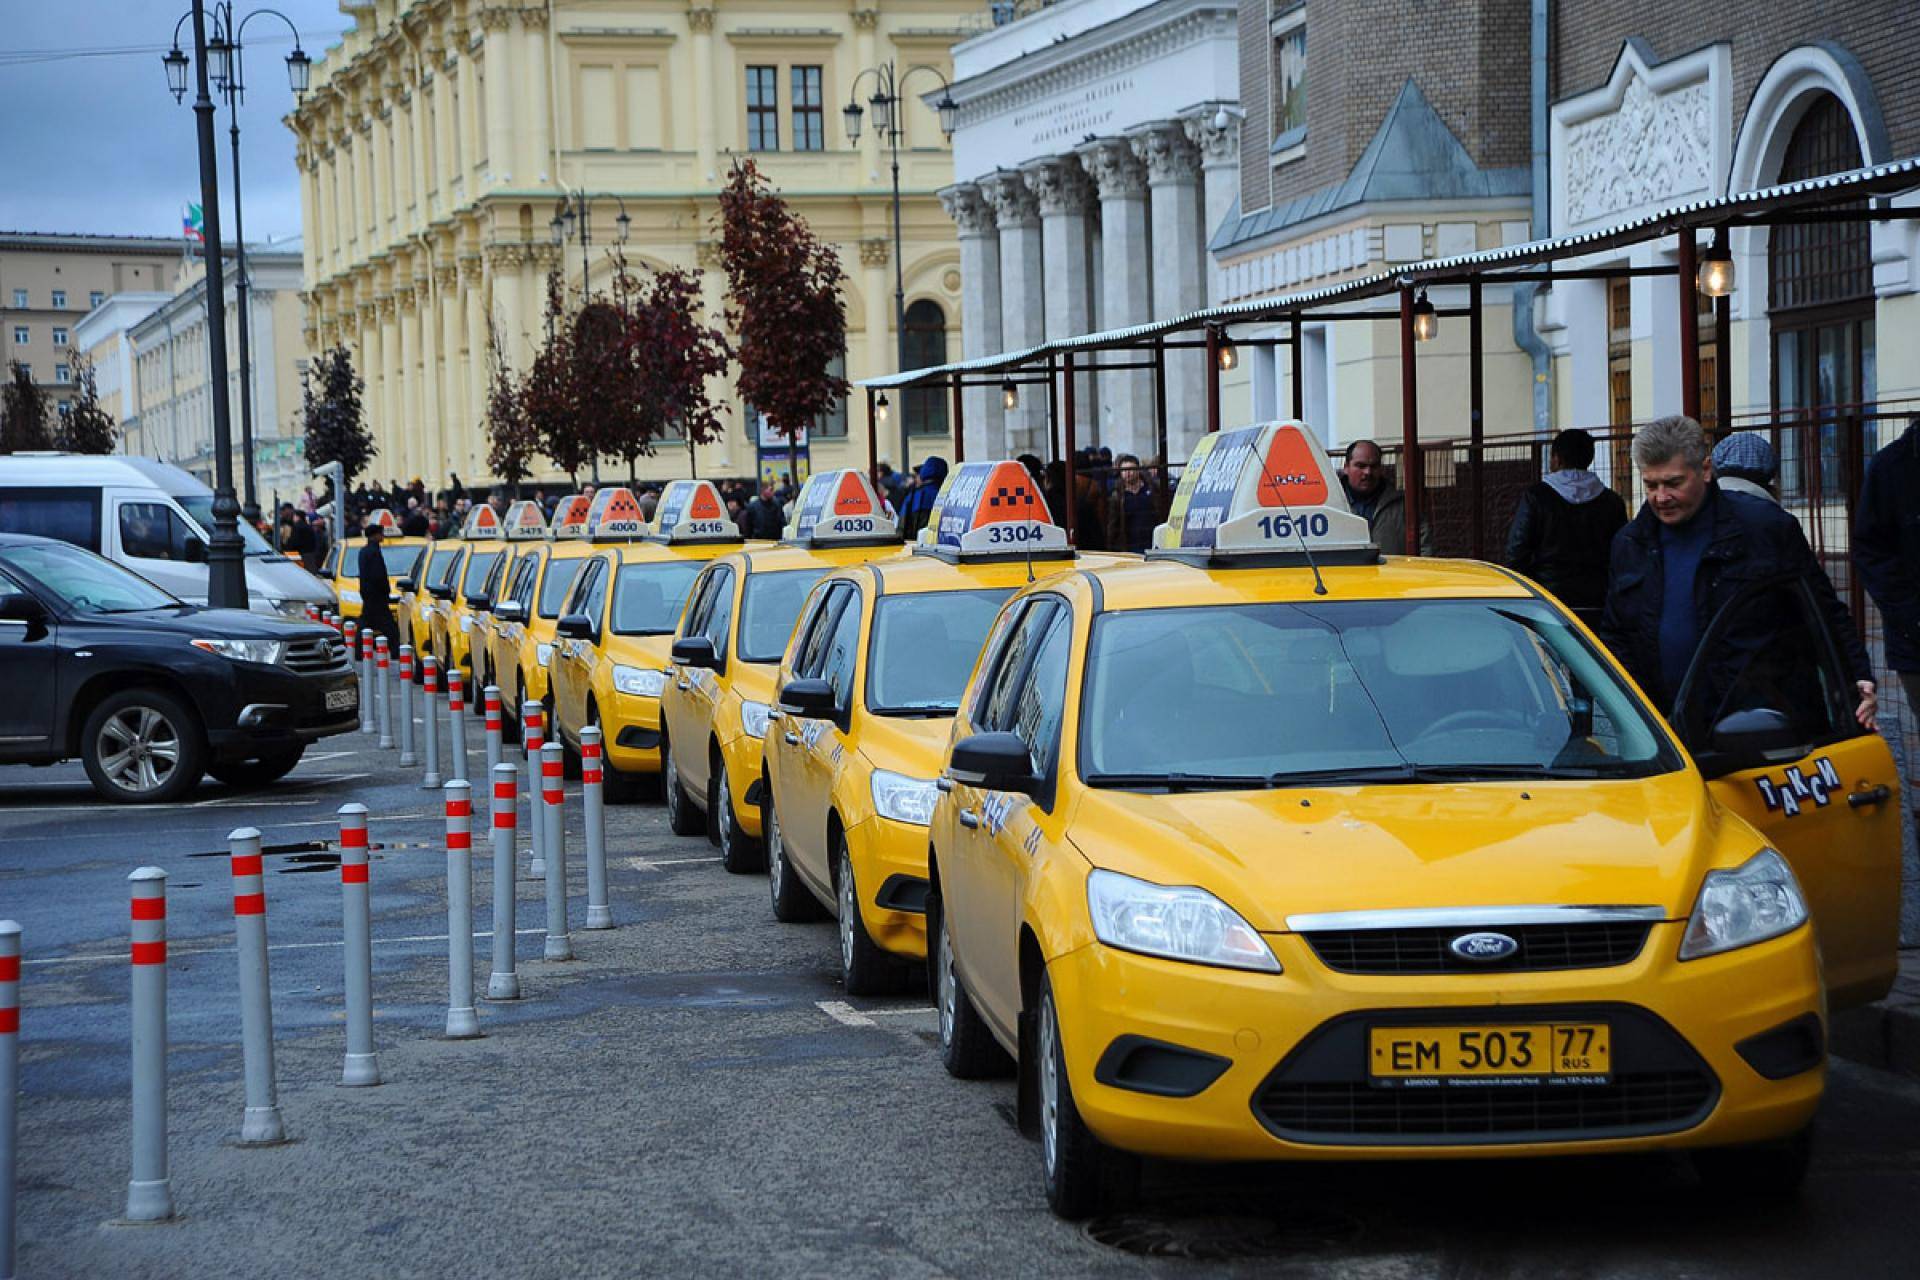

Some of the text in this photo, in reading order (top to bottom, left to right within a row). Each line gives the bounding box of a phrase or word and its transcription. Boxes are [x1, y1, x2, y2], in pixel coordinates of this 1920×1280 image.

[689, 522, 723, 534] 3416
[833, 519, 873, 532] 4030
[1257, 513, 1329, 539] 1610
[988, 525, 1044, 543] 3304
[1756, 757, 1841, 816] ТАКСИ
[1467, 938, 1505, 953] Ford
[1458, 1031, 1533, 1069] 503
[1557, 1028, 1595, 1056] 77
[1562, 1058, 1591, 1069] RUS
